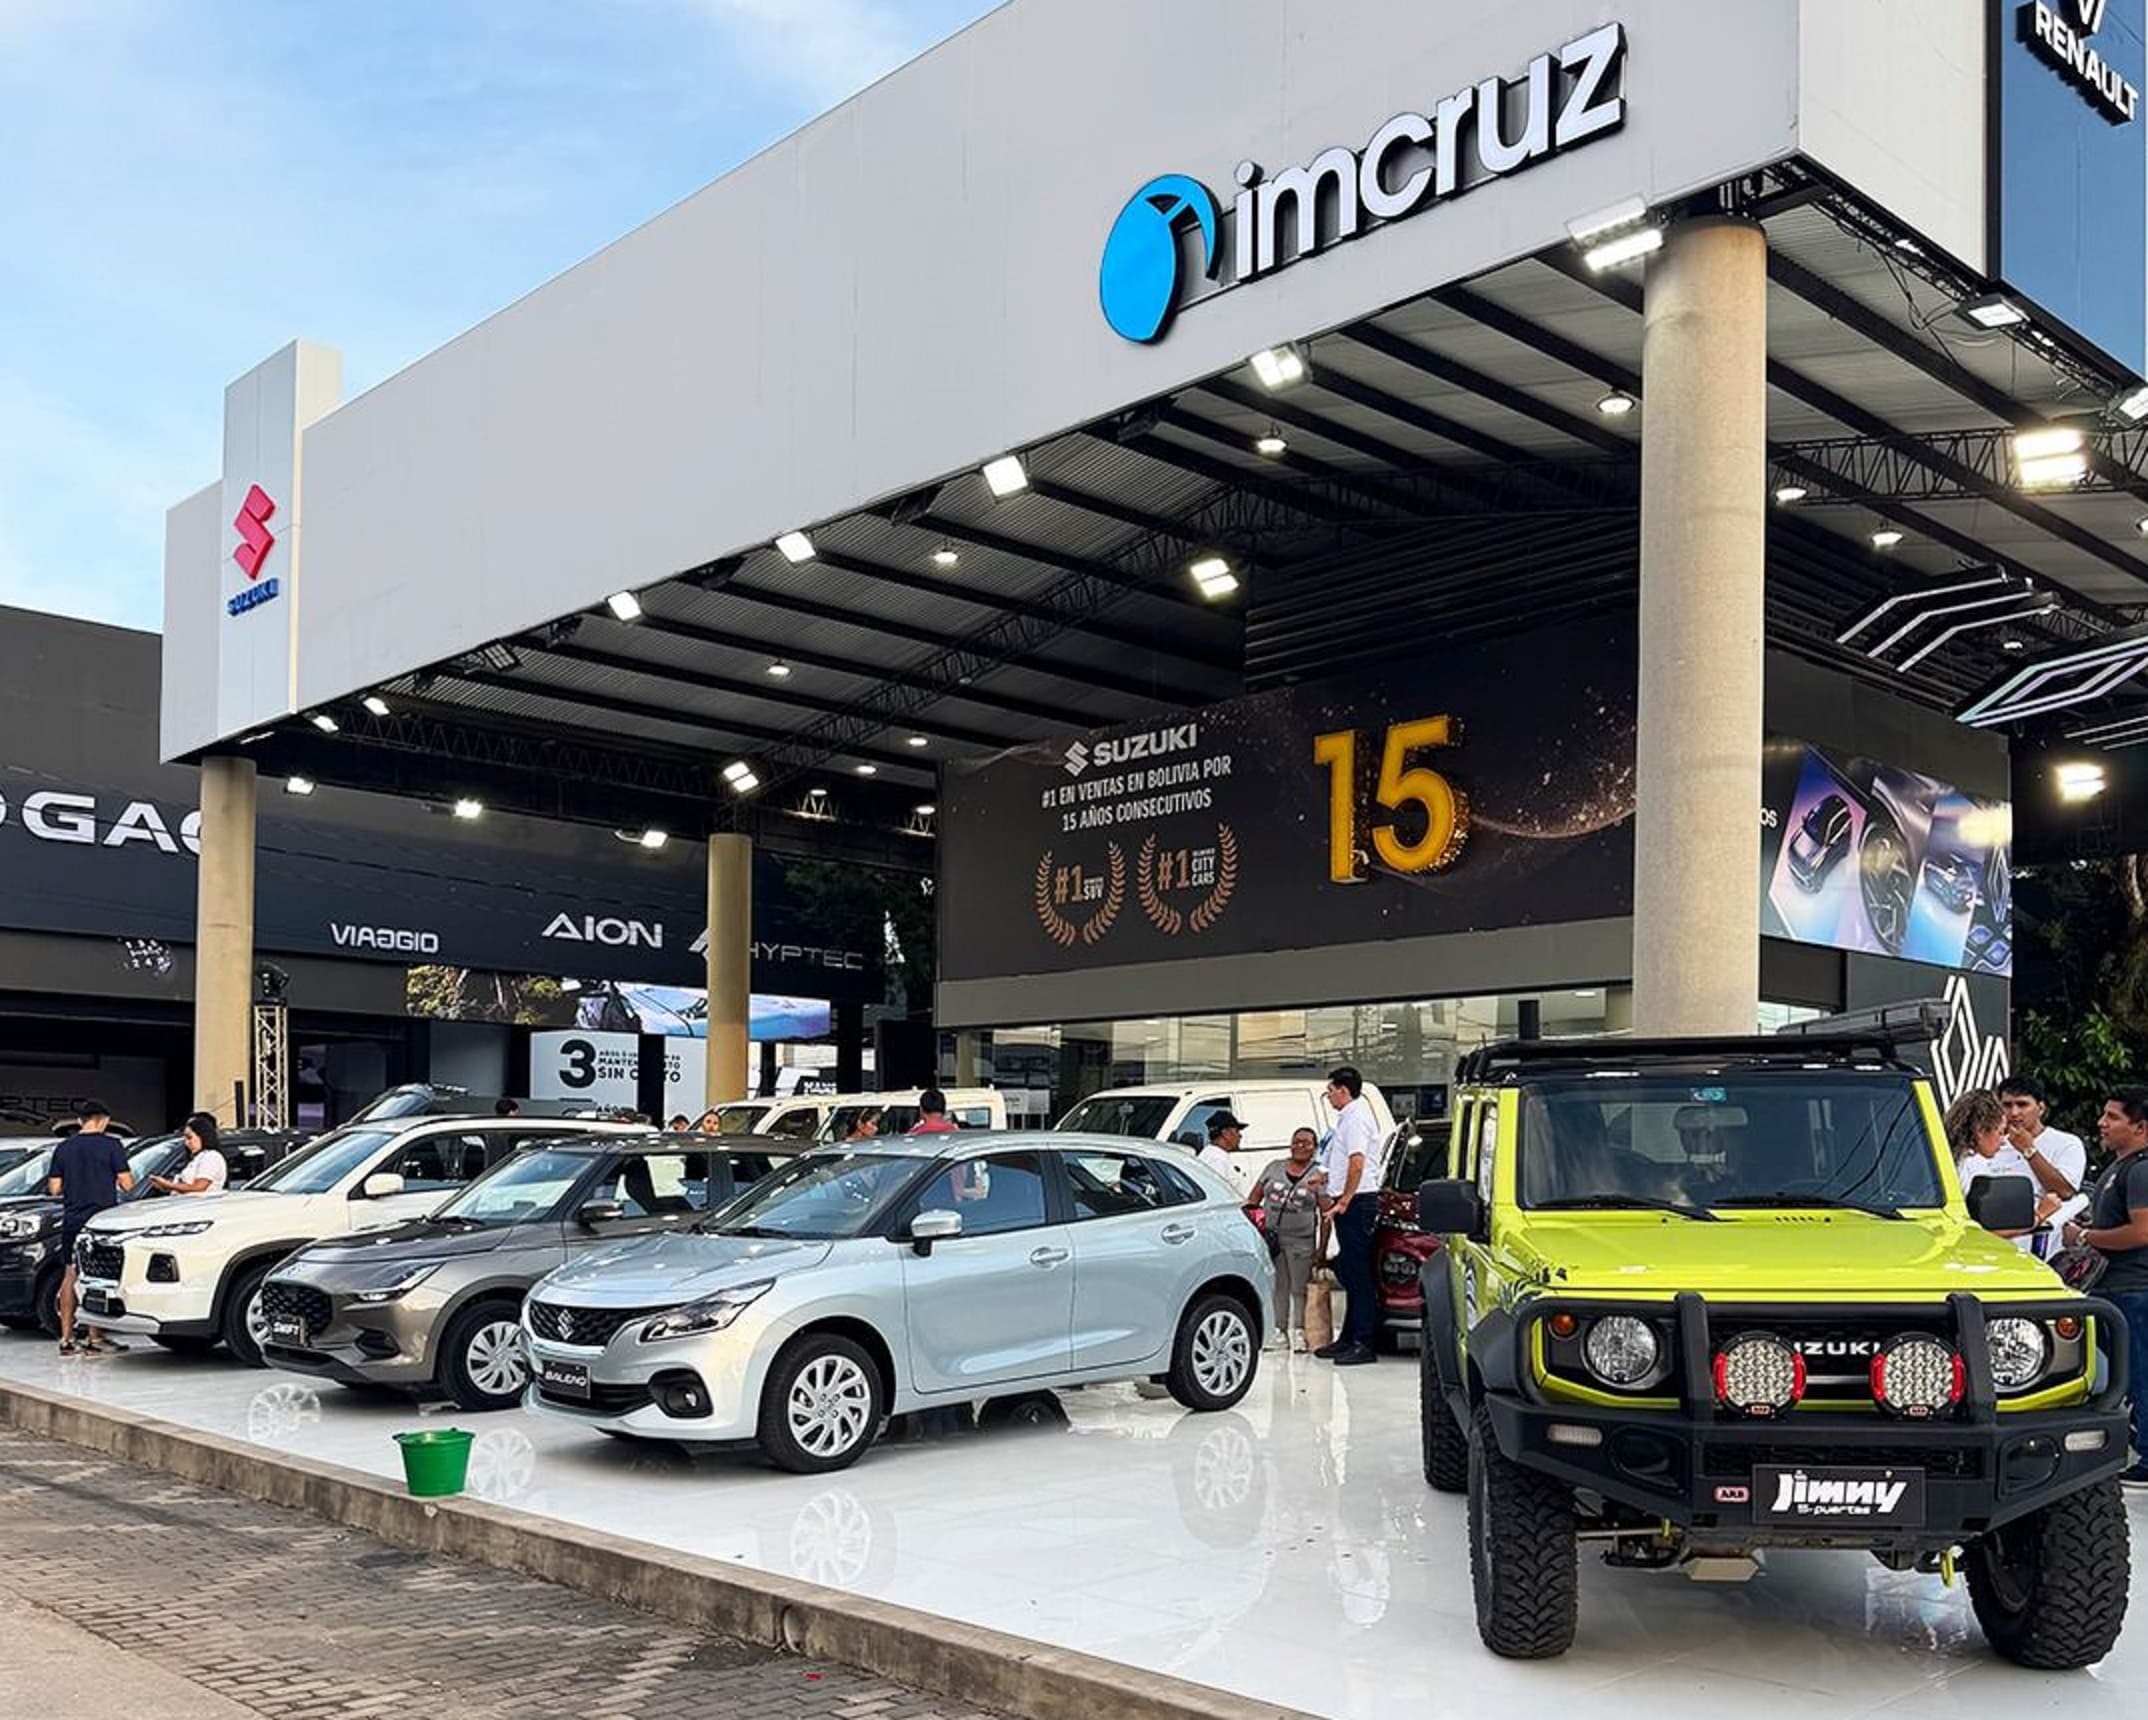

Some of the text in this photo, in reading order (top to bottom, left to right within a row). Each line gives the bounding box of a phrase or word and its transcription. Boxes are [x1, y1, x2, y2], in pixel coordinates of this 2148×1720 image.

[2035, 0, 2138, 120] RENAULT
[1234, 22, 1626, 282] imcruz
[227, 577, 278, 616] SUZUKI
[1093, 723, 1197, 767] SUZUKI
[1042, 755, 1231, 808] #1 EN VENTAS EN BOLIVIA POR
[1314, 714, 1460, 882] 15
[1062, 787, 1212, 831] 15 AÑOS CONSECUTIVOS
[1055, 865, 1084, 904] #1
[1158, 850, 1190, 891] #1
[1191, 855, 1216, 873] CITY
[541, 912, 663, 948] AION
[559, 1039, 596, 1088] 3
[599, 1067, 624, 1079] SIN
[1771, 1469, 1908, 1513] Jimny
